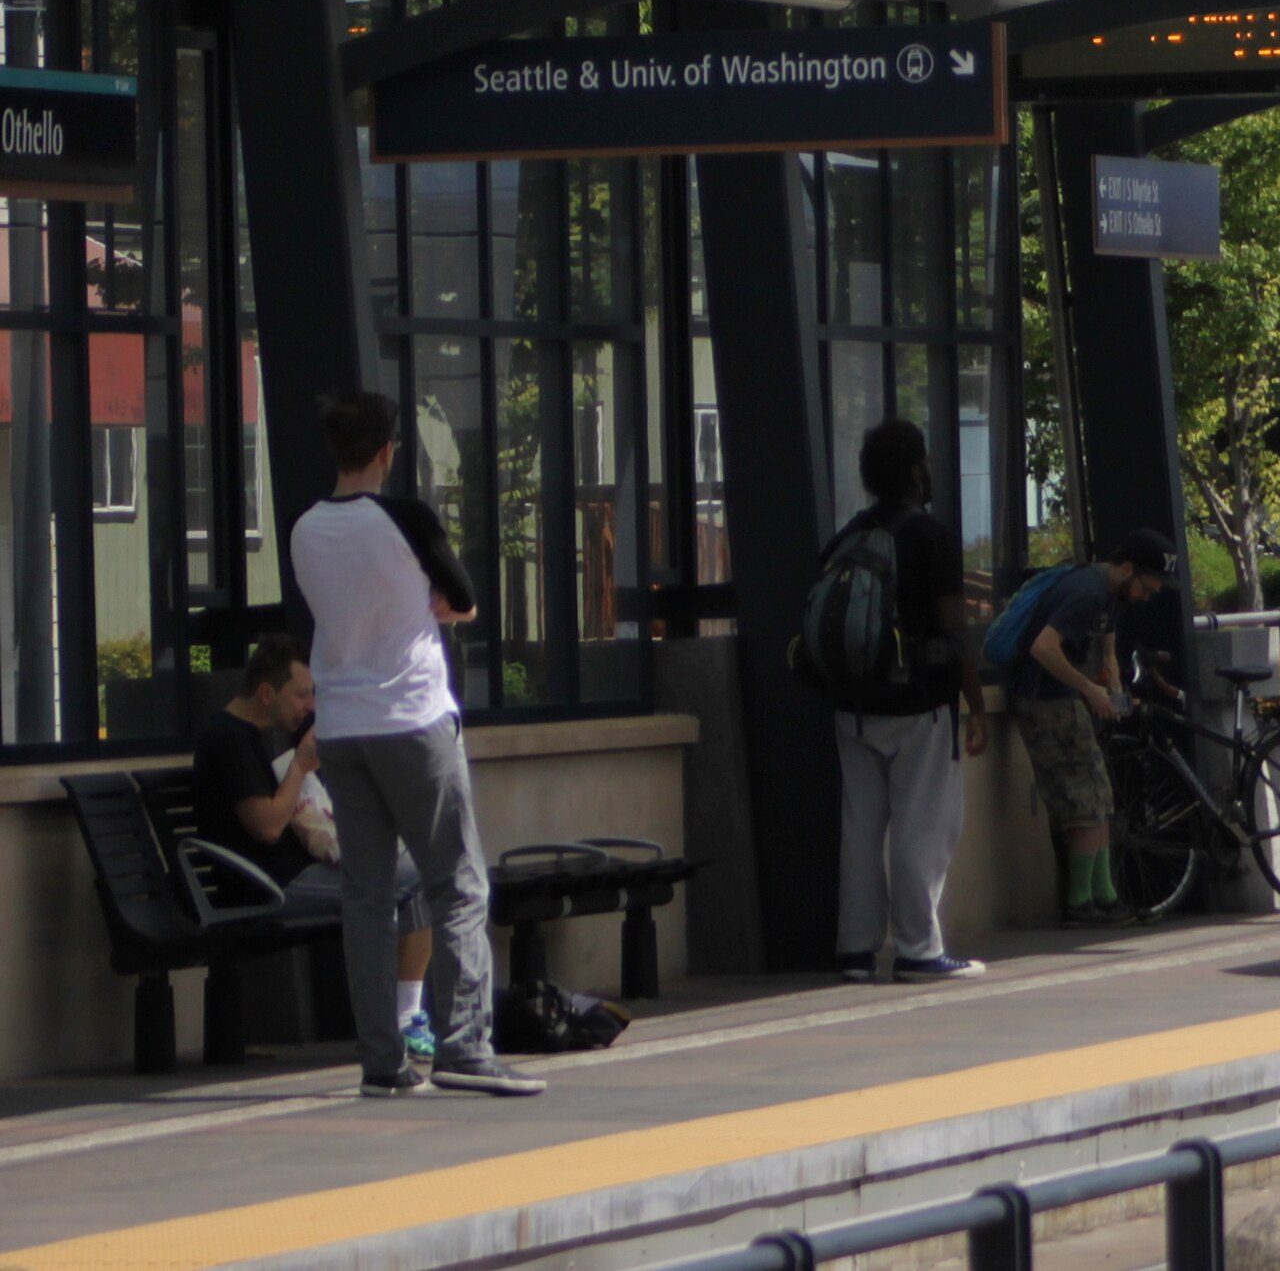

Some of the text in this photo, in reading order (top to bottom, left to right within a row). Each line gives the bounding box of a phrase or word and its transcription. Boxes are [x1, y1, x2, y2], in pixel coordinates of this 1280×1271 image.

[474, 52, 886, 93] Seattle & Univ. of Washington
[1, 107, 63, 156] Othello
